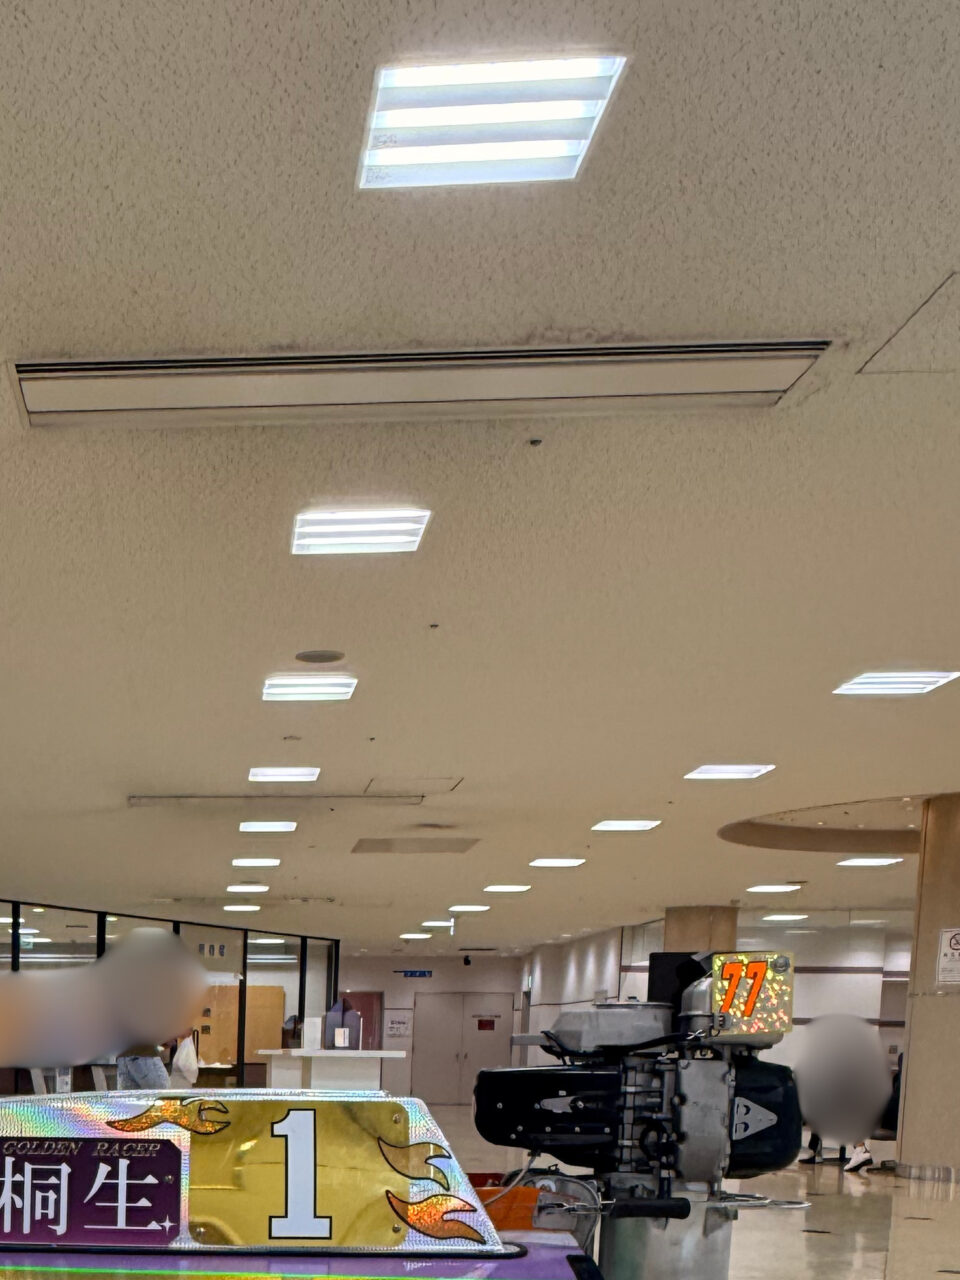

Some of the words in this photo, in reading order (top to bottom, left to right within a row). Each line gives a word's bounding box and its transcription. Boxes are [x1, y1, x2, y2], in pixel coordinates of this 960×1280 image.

[720, 961, 768, 1018] 77
[2, 1141, 83, 1156] GOLDEN
[91, 1142, 161, 1157] RACER
[268, 1108, 332, 1240] 1
